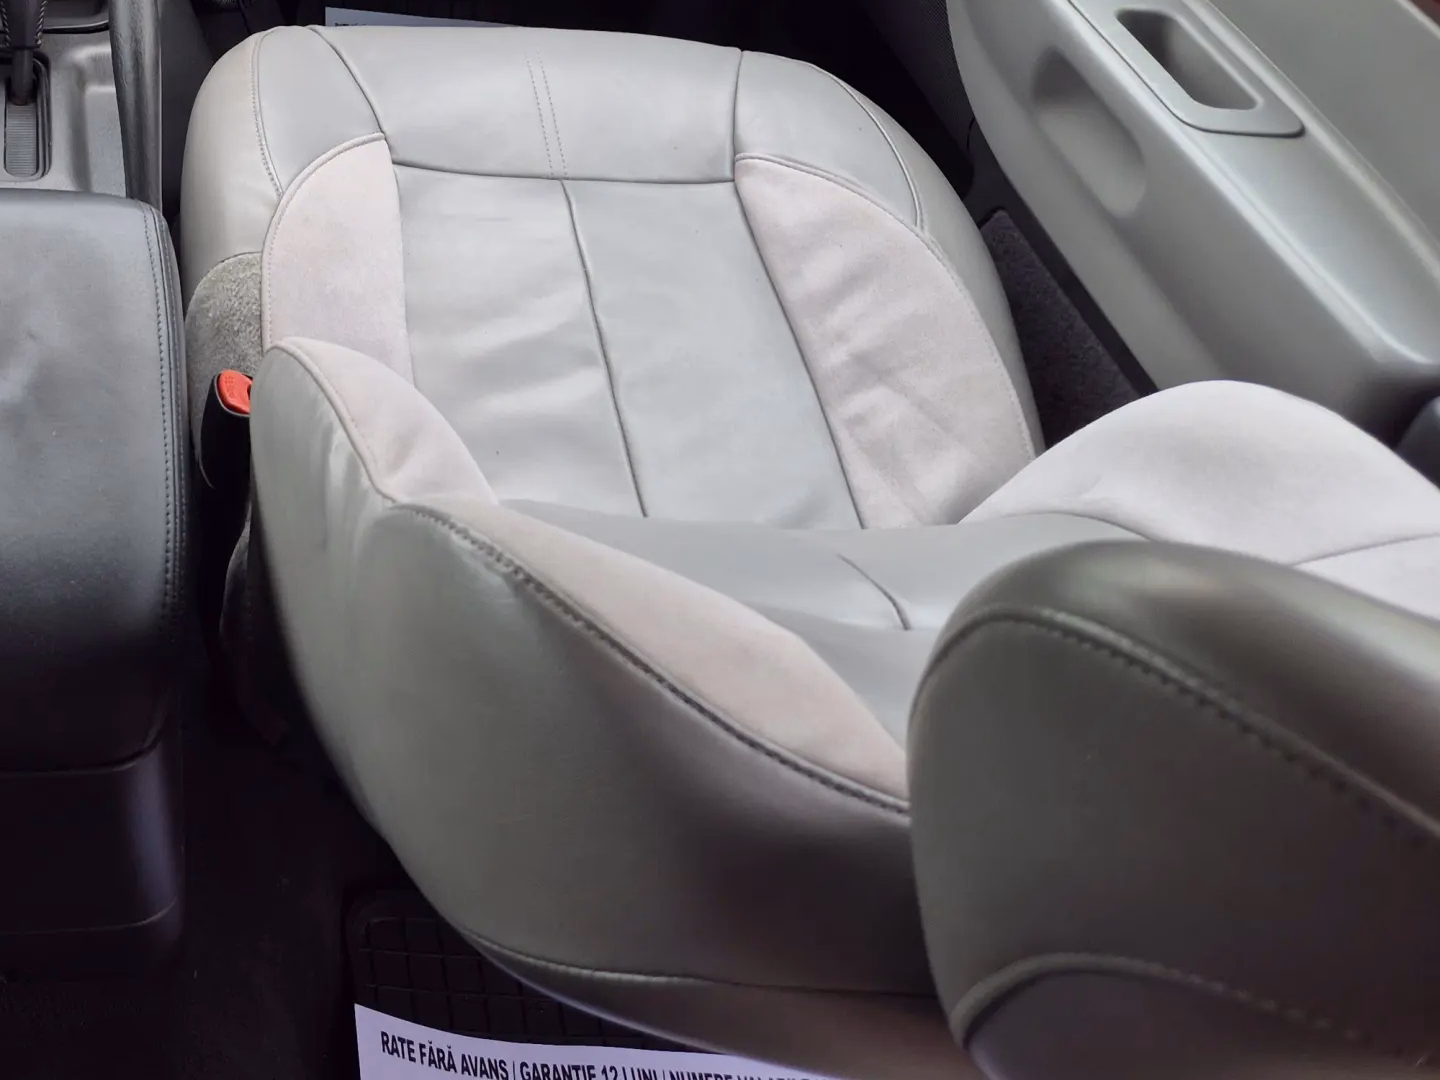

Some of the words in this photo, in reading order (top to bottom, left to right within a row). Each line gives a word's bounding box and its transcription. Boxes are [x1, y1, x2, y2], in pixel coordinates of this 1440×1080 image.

[380, 1031, 417, 1063] RATE
[419, 1040, 458, 1074] FĂRĂ
[461, 1054, 510, 1080] AVANS
